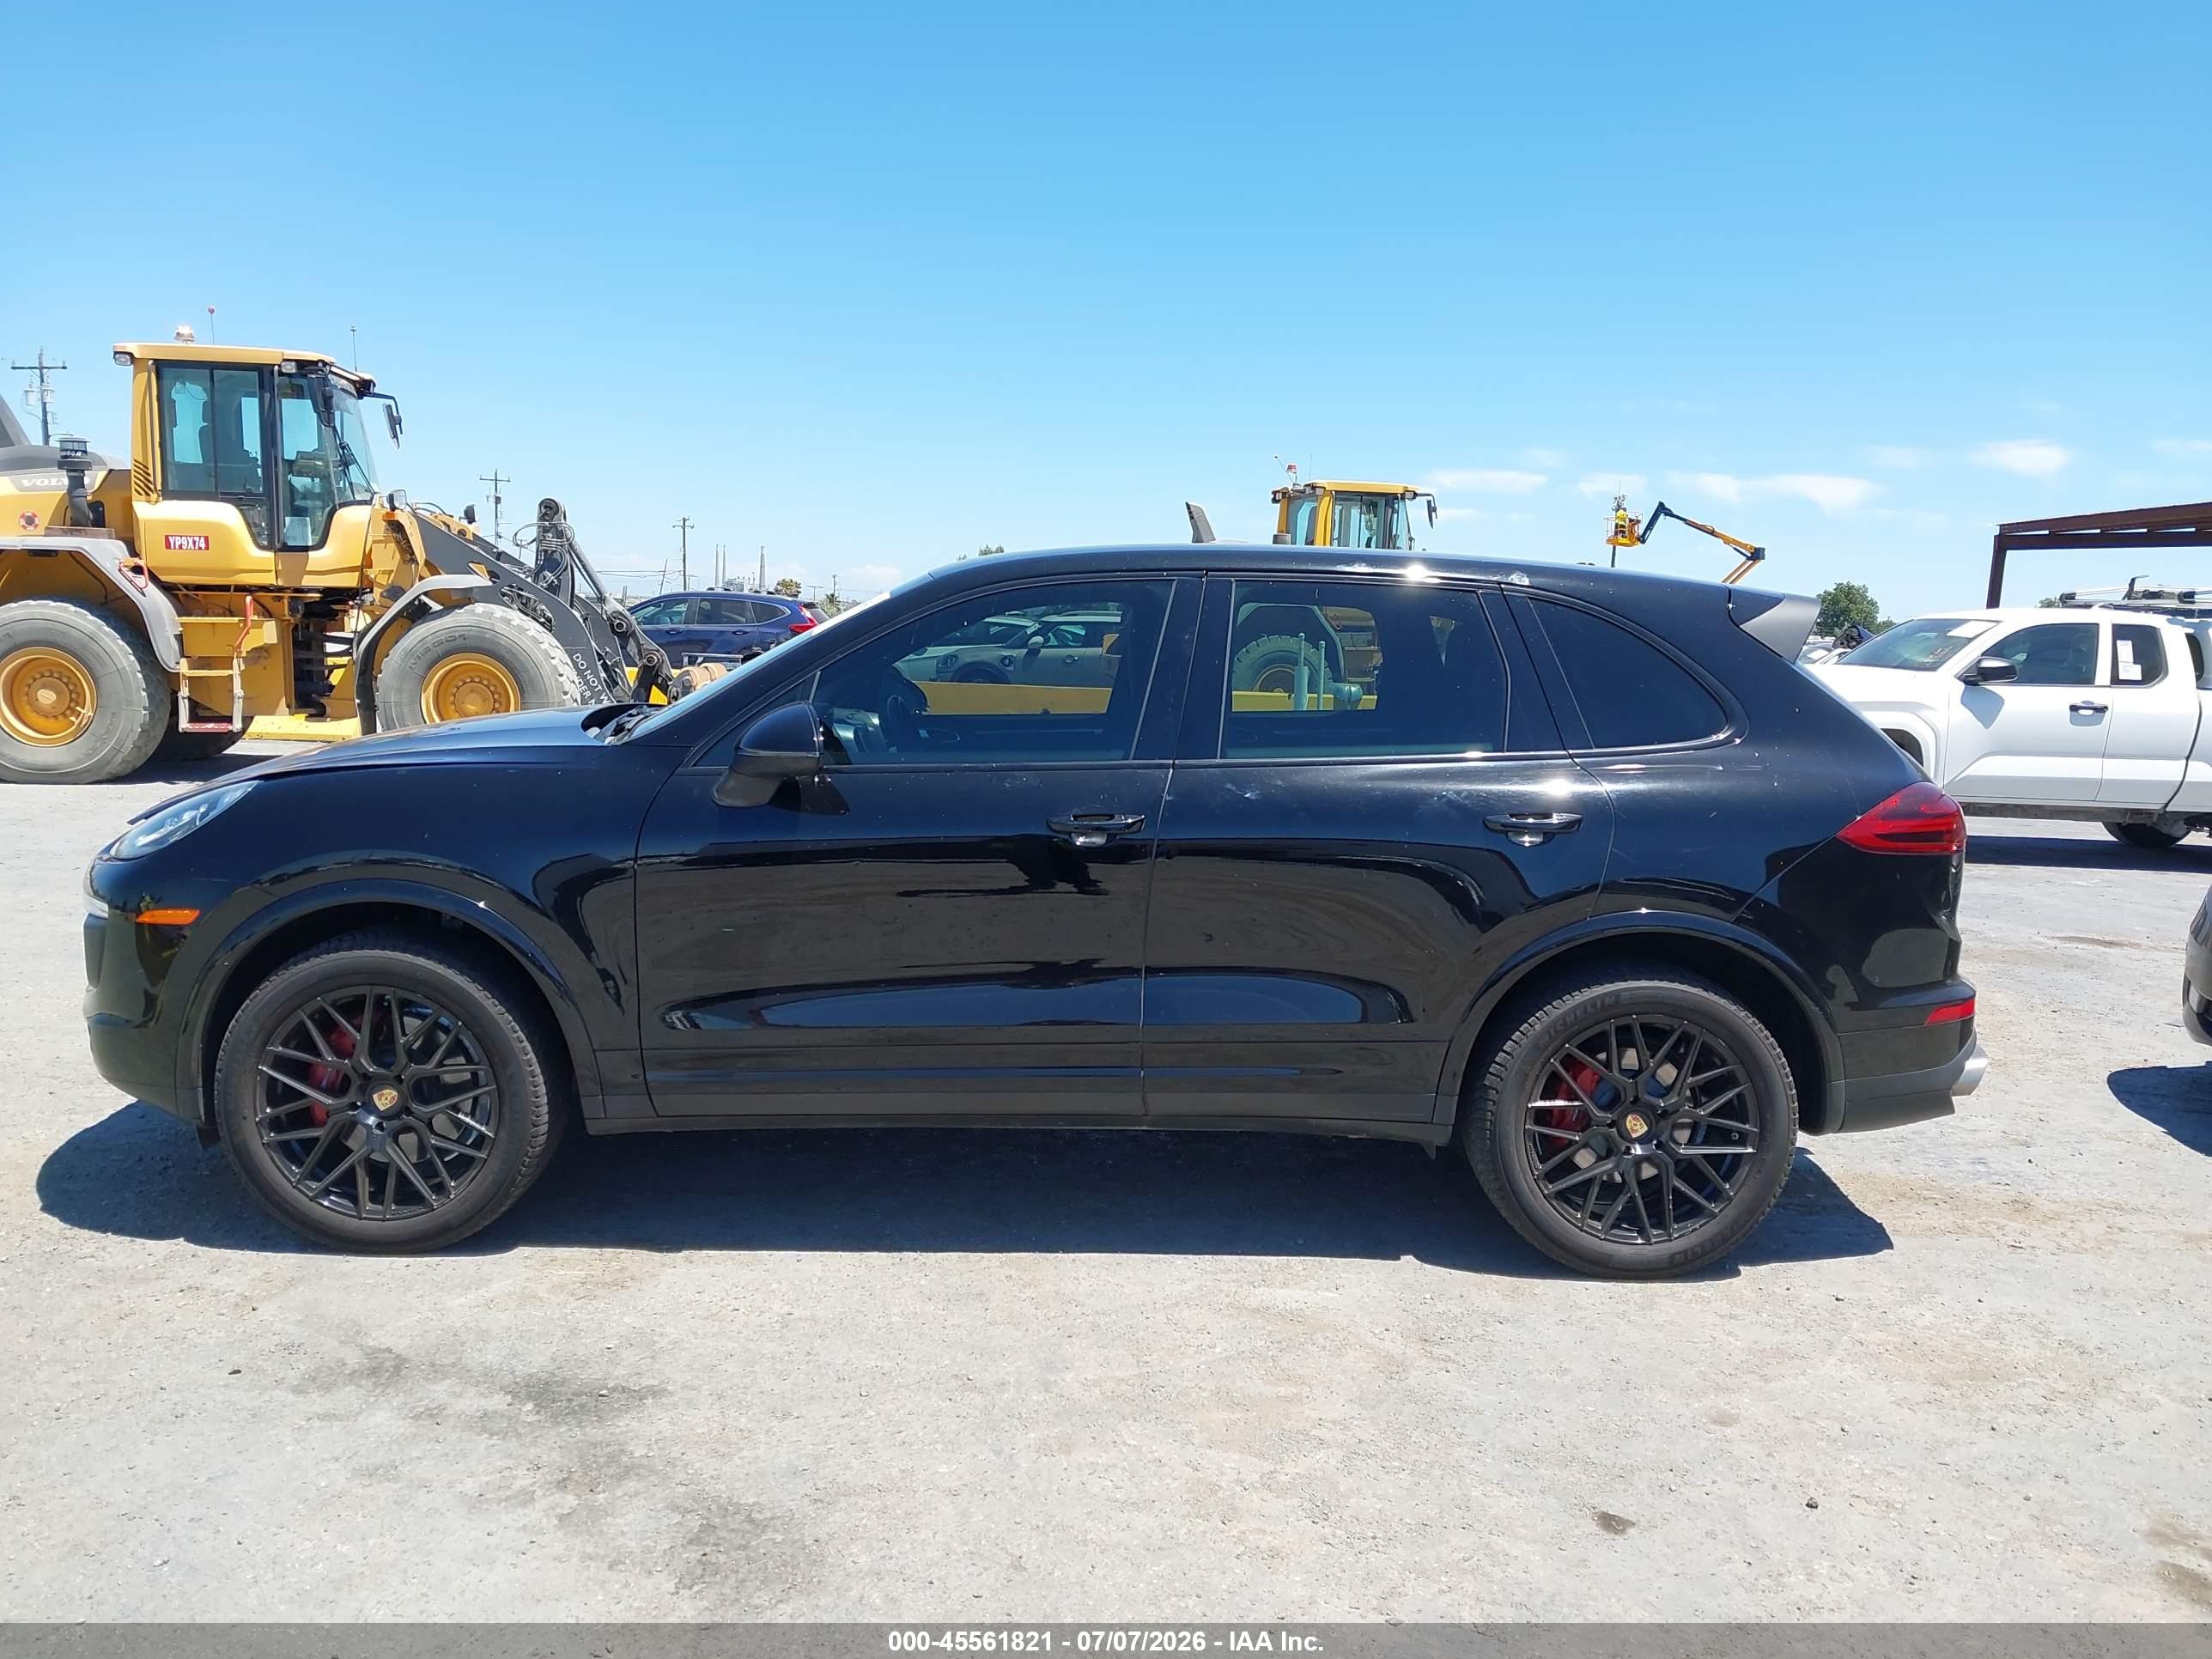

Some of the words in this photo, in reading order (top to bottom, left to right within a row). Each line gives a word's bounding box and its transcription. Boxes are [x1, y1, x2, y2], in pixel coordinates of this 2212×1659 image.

[168, 536, 206, 550] YP9X74
[573, 653, 587, 670] DO
[584, 670, 603, 691] NOT
